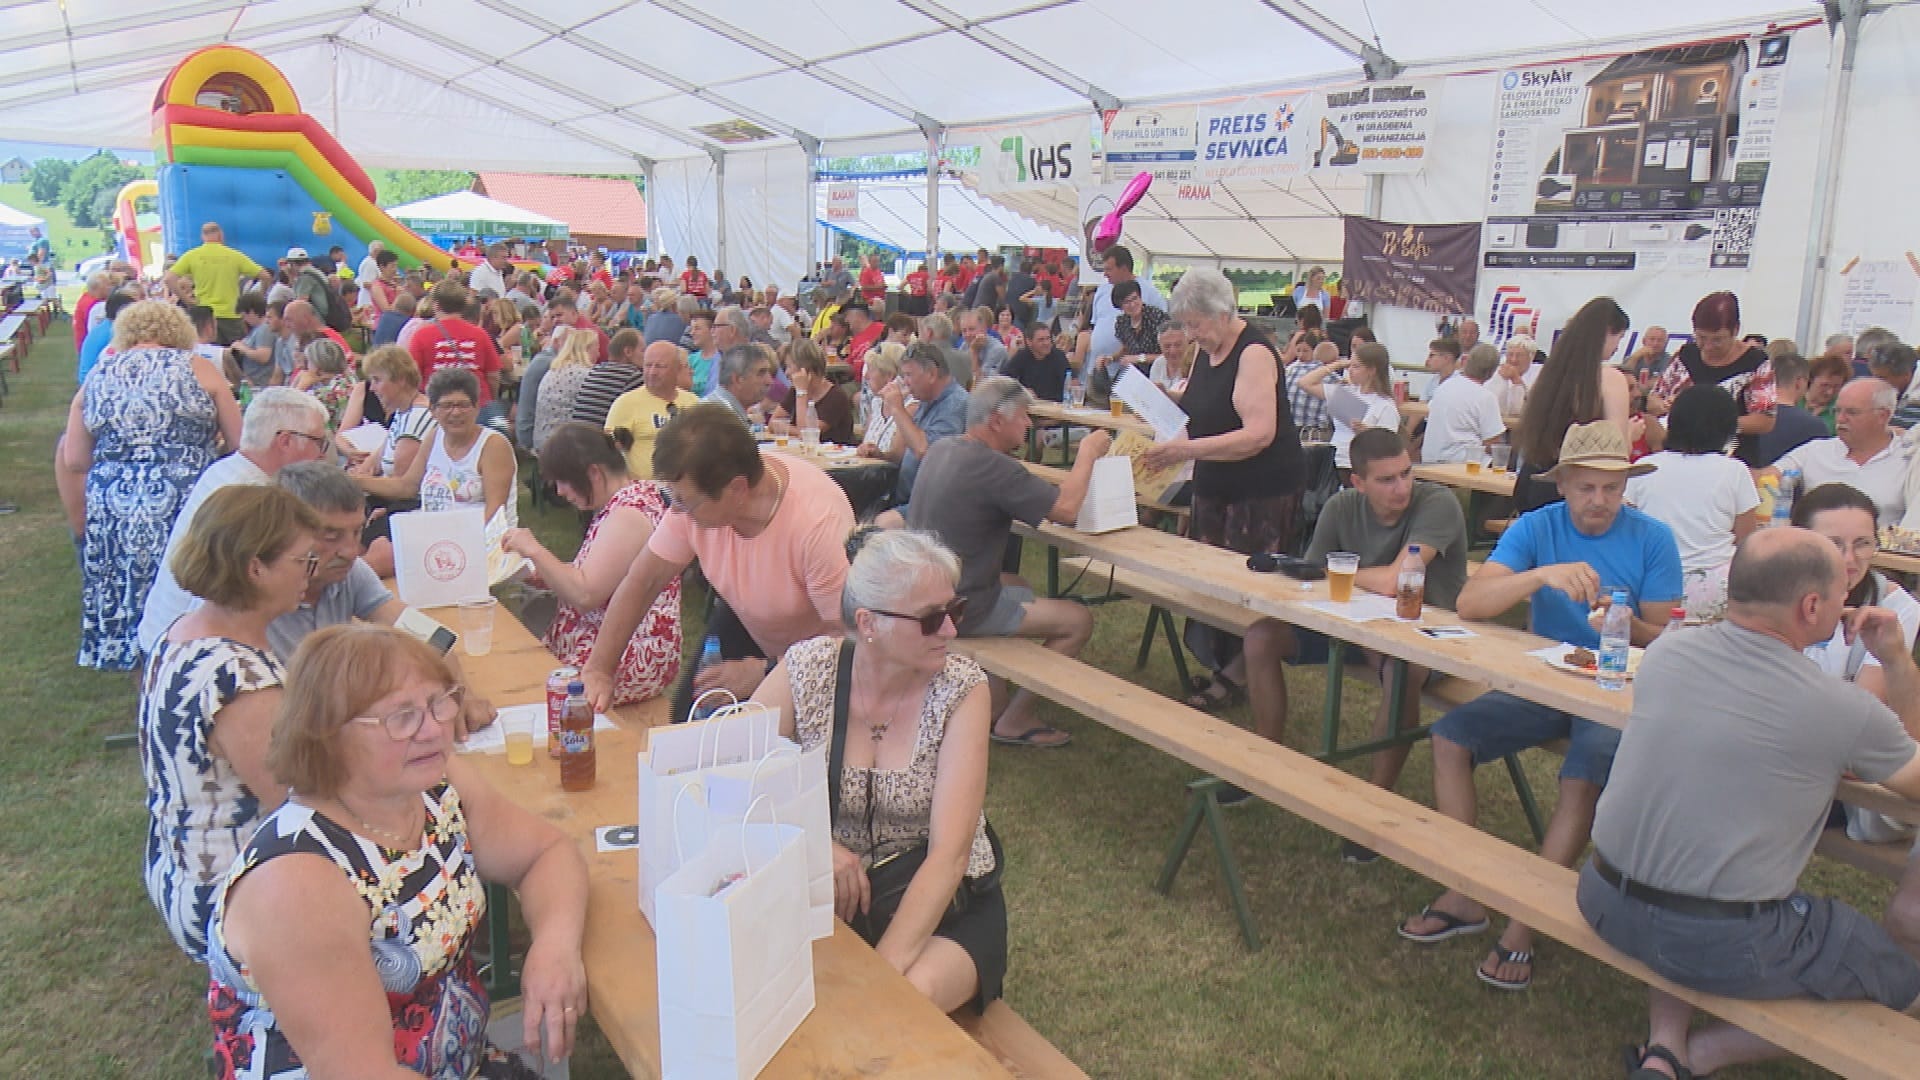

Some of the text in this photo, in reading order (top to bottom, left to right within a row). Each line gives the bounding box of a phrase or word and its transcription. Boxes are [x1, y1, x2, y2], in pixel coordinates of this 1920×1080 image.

[1521, 69, 1572, 88] SkyAir
[1208, 114, 1267, 136] PREIS
[1204, 136, 1288, 160] SEVNICA
[1029, 143, 1073, 180] IHS
[1178, 185, 1211, 200] HRANA
